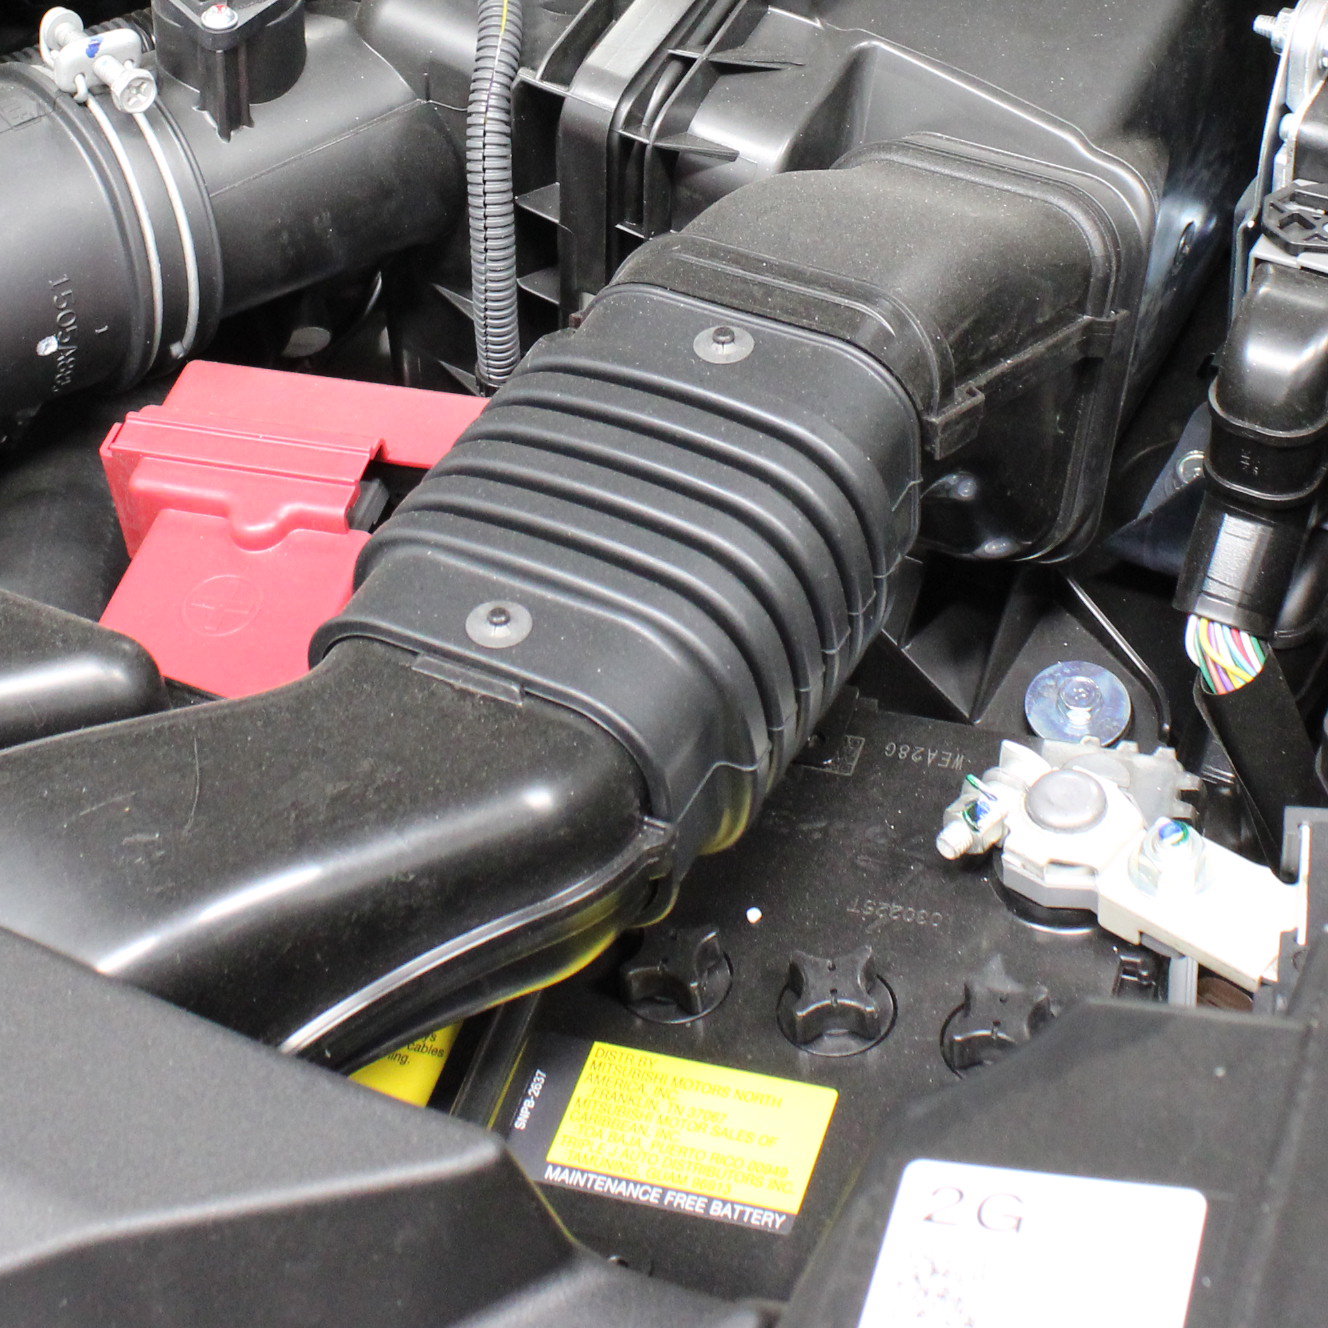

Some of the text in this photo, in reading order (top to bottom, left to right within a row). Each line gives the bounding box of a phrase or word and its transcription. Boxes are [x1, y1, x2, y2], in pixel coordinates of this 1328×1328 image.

[884, 741, 965, 771] WEA28G
[589, 1059, 784, 1108] MITSUBISHI MOTORS NORTH
[573, 1096, 780, 1149] MITSUBISHI MOTOR SALES OF
[665, 1102, 686, 1116] TN
[558, 1133, 608, 1154] TRIPLE
[619, 1146, 661, 1166] AUTO
[659, 1155, 766, 1188] DISTRIBUTORS
[648, 1139, 708, 1162] PUERTO
[708, 1151, 746, 1169] RICO
[643, 1165, 690, 1186] GUAM
[544, 1164, 787, 1230] MAINTENANCE FREE BATTERY
